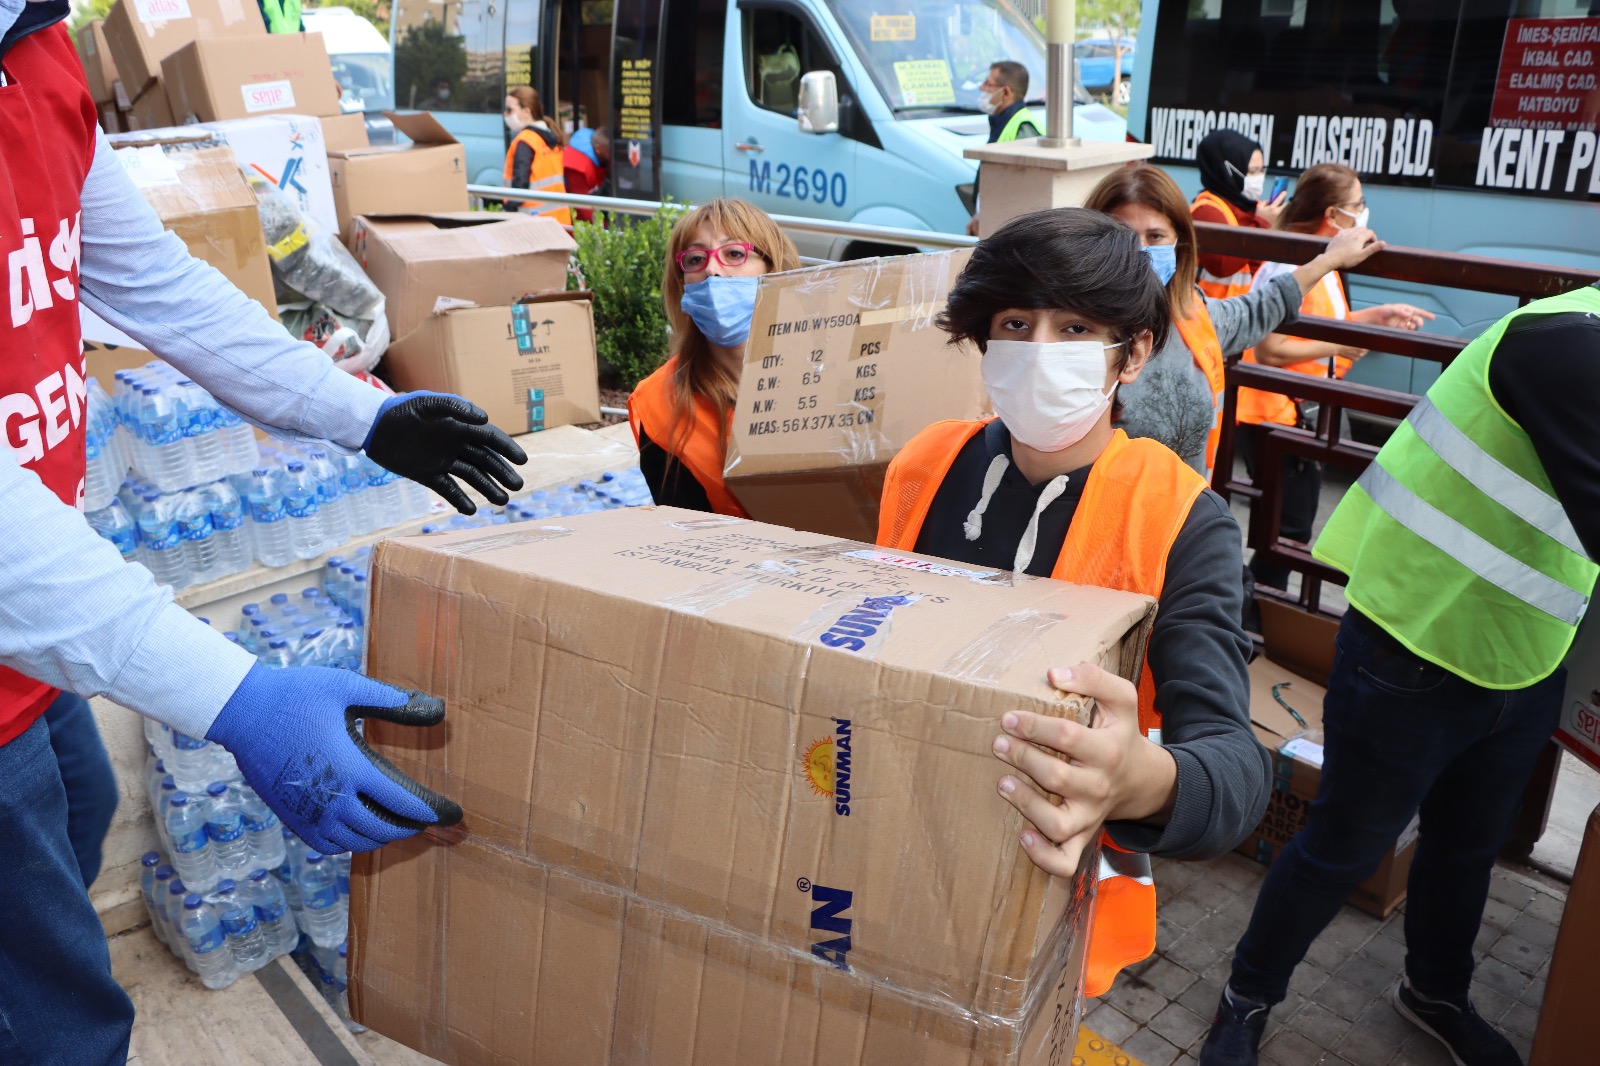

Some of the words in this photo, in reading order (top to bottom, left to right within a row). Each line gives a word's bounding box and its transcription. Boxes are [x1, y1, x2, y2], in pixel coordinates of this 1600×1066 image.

[1517, 24, 1600, 46] İMES-ŞERİFA
[1522, 48, 1559, 66] İKBAL
[1564, 50, 1594, 66] CAD.
[1509, 73, 1565, 93] ELALMIŞ
[1567, 74, 1597, 90] CAD.
[1518, 96, 1580, 113] HATBOYU
[1388, 118, 1435, 178] BLD.
[1475, 127, 1565, 191] KENT
[768, 322, 791, 337] ITEM
[762, 355, 784, 369] QTY:
[810, 349, 823, 362] 12
[860, 341, 881, 356] PCS
[856, 363, 877, 378] KGS
[798, 395, 817, 410] 5.5
[854, 386, 876, 401] KGS
[638, 544, 740, 565] SUNMAN
[819, 594, 912, 652] SUN
[836, 718, 852, 817] SUNMAN
